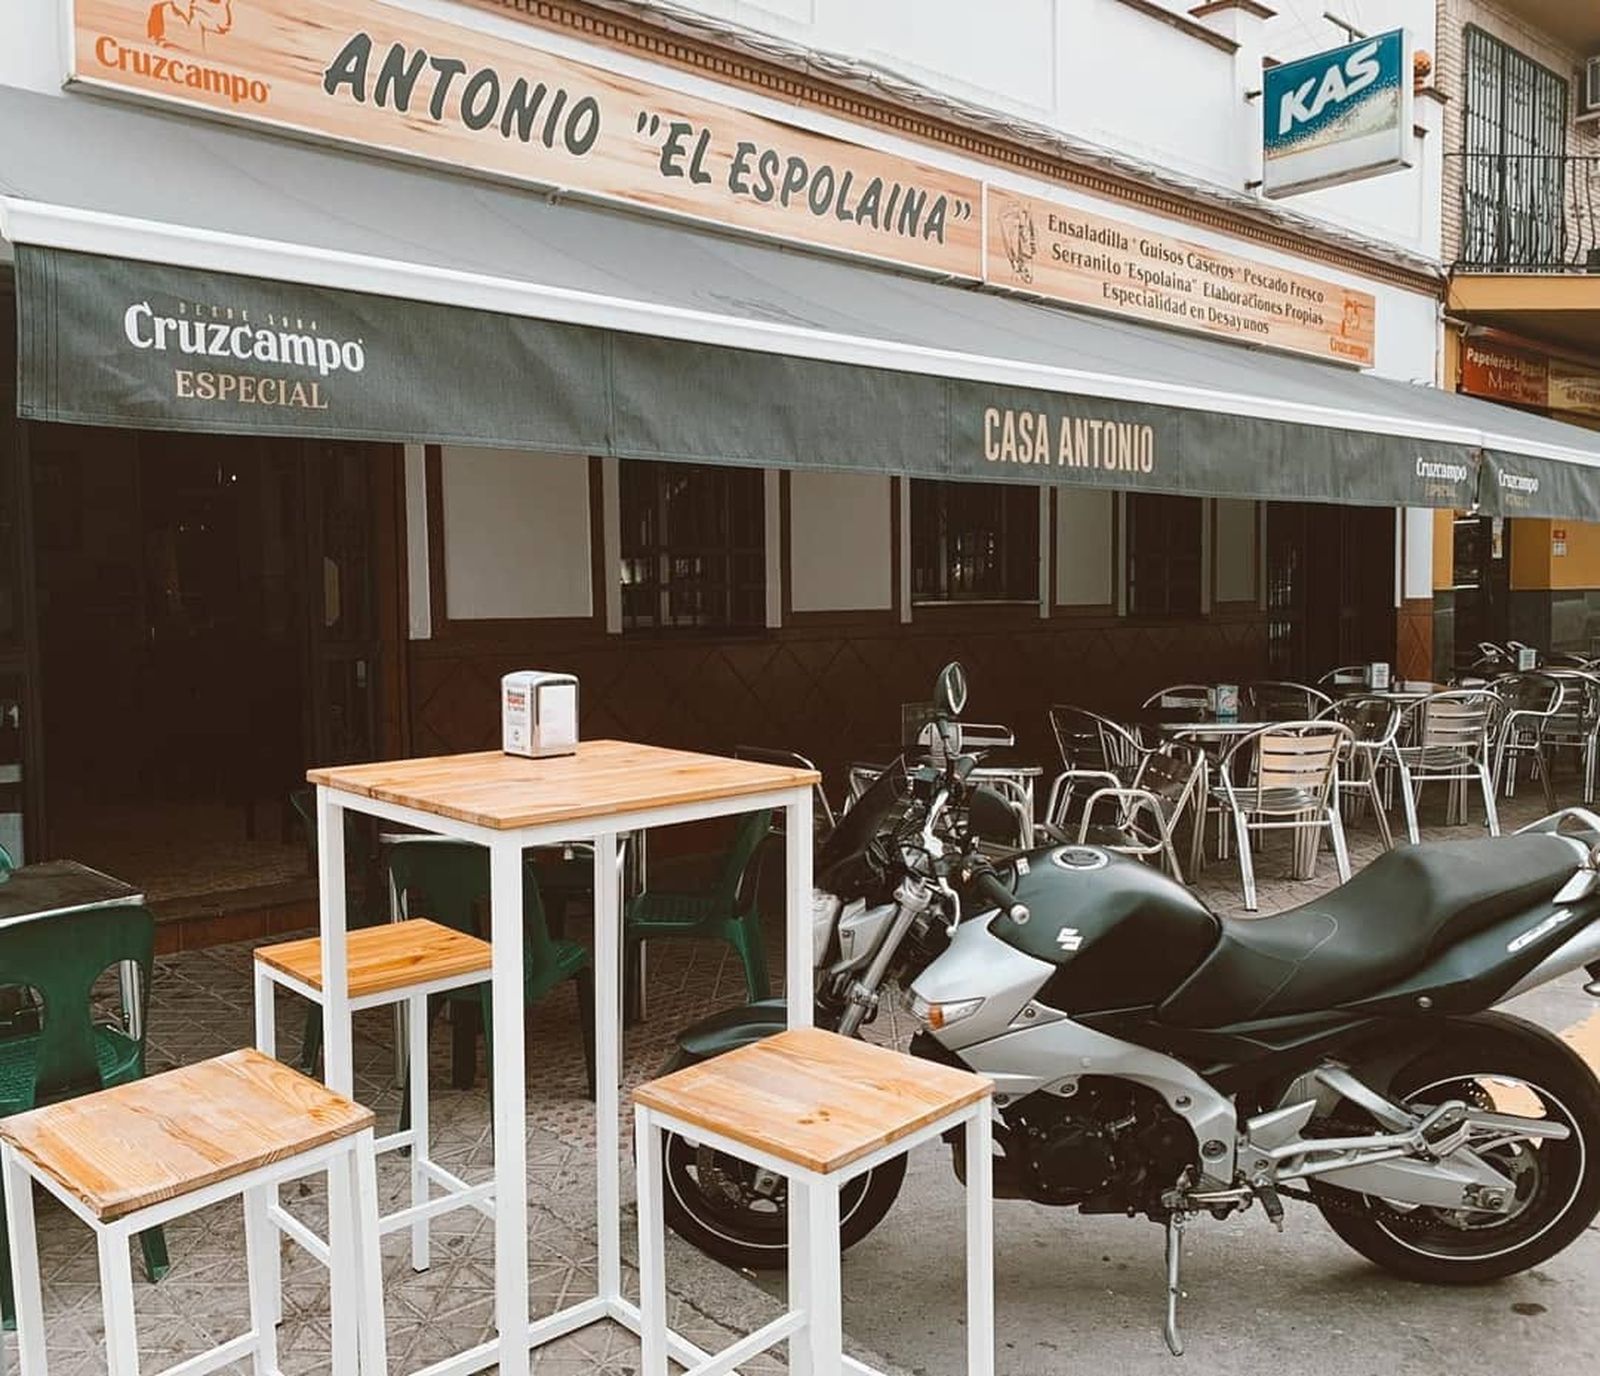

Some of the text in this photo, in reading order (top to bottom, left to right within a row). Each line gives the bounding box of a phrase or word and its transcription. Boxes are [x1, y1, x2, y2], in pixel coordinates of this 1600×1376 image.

[95, 35, 269, 104] Cruzcampo
[323, 31, 600, 156] ANTONIO
[1279, 41, 1380, 135] KAS
[1048, 213, 1325, 304] Ensaladilla Guisos Caseros Pescado Fresco
[1051, 242, 1122, 275] Serranito
[1203, 281, 1283, 315] Elaboraciones
[1285, 303, 1325, 325] Propias
[123, 302, 366, 376] Cruzcampo
[1102, 281, 1270, 335] Especialidad en Desayunos
[175, 369, 329, 409] ESPECIAL
[984, 407, 1153, 473] CASA ANTONIO
[1416, 457, 1468, 483] Cruzcampo
